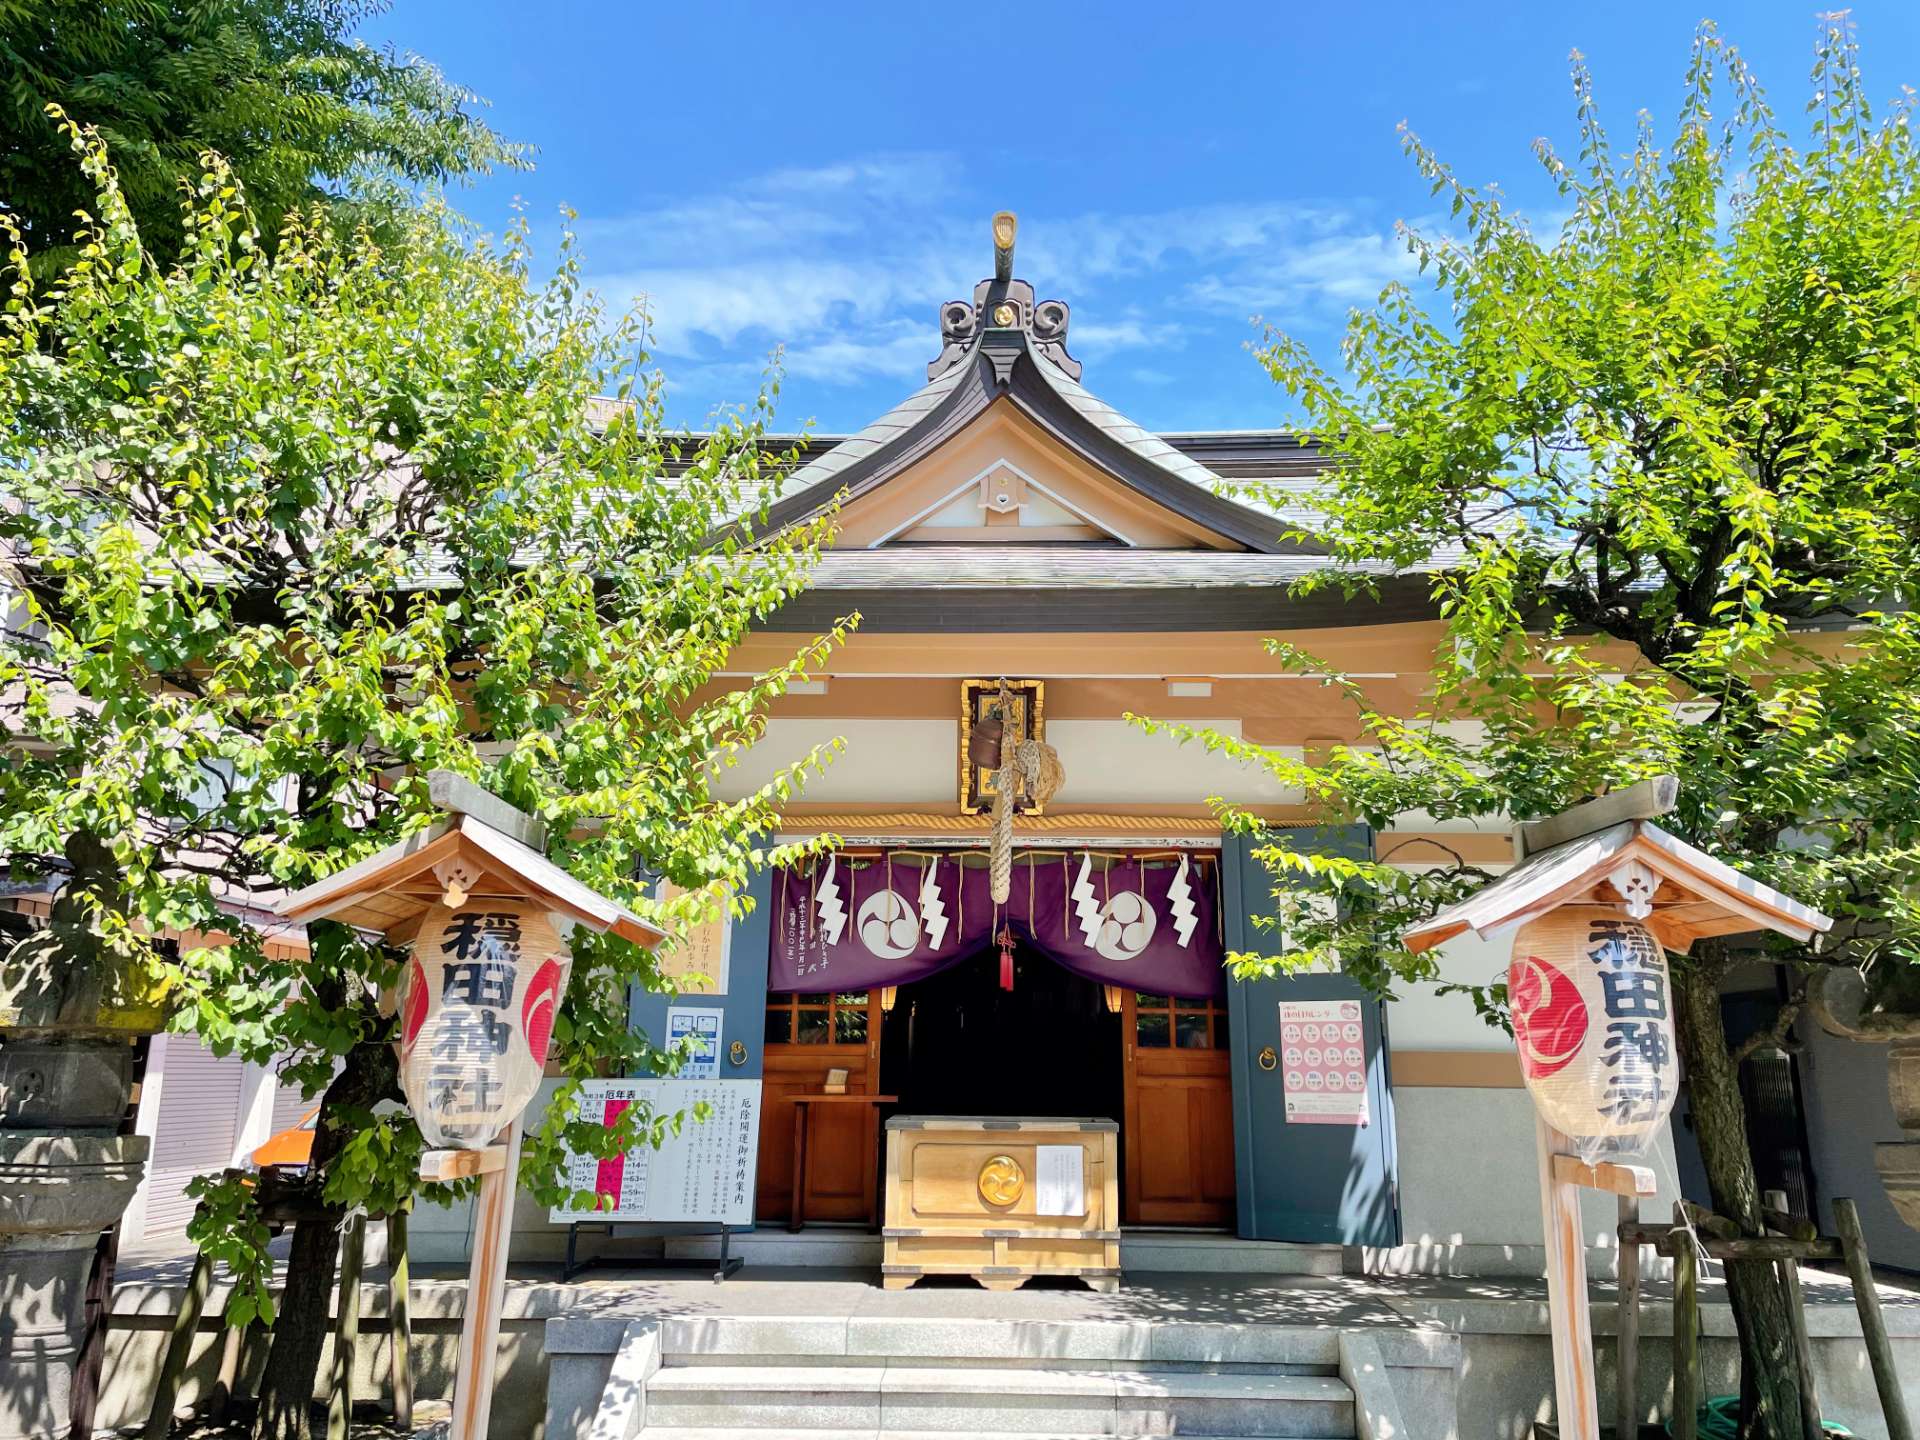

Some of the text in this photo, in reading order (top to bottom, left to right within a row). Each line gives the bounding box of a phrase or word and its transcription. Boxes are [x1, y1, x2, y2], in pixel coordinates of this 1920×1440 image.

[428, 912, 522, 1112] 穏田神社
[1587, 920, 1670, 1126] 穏田神社
